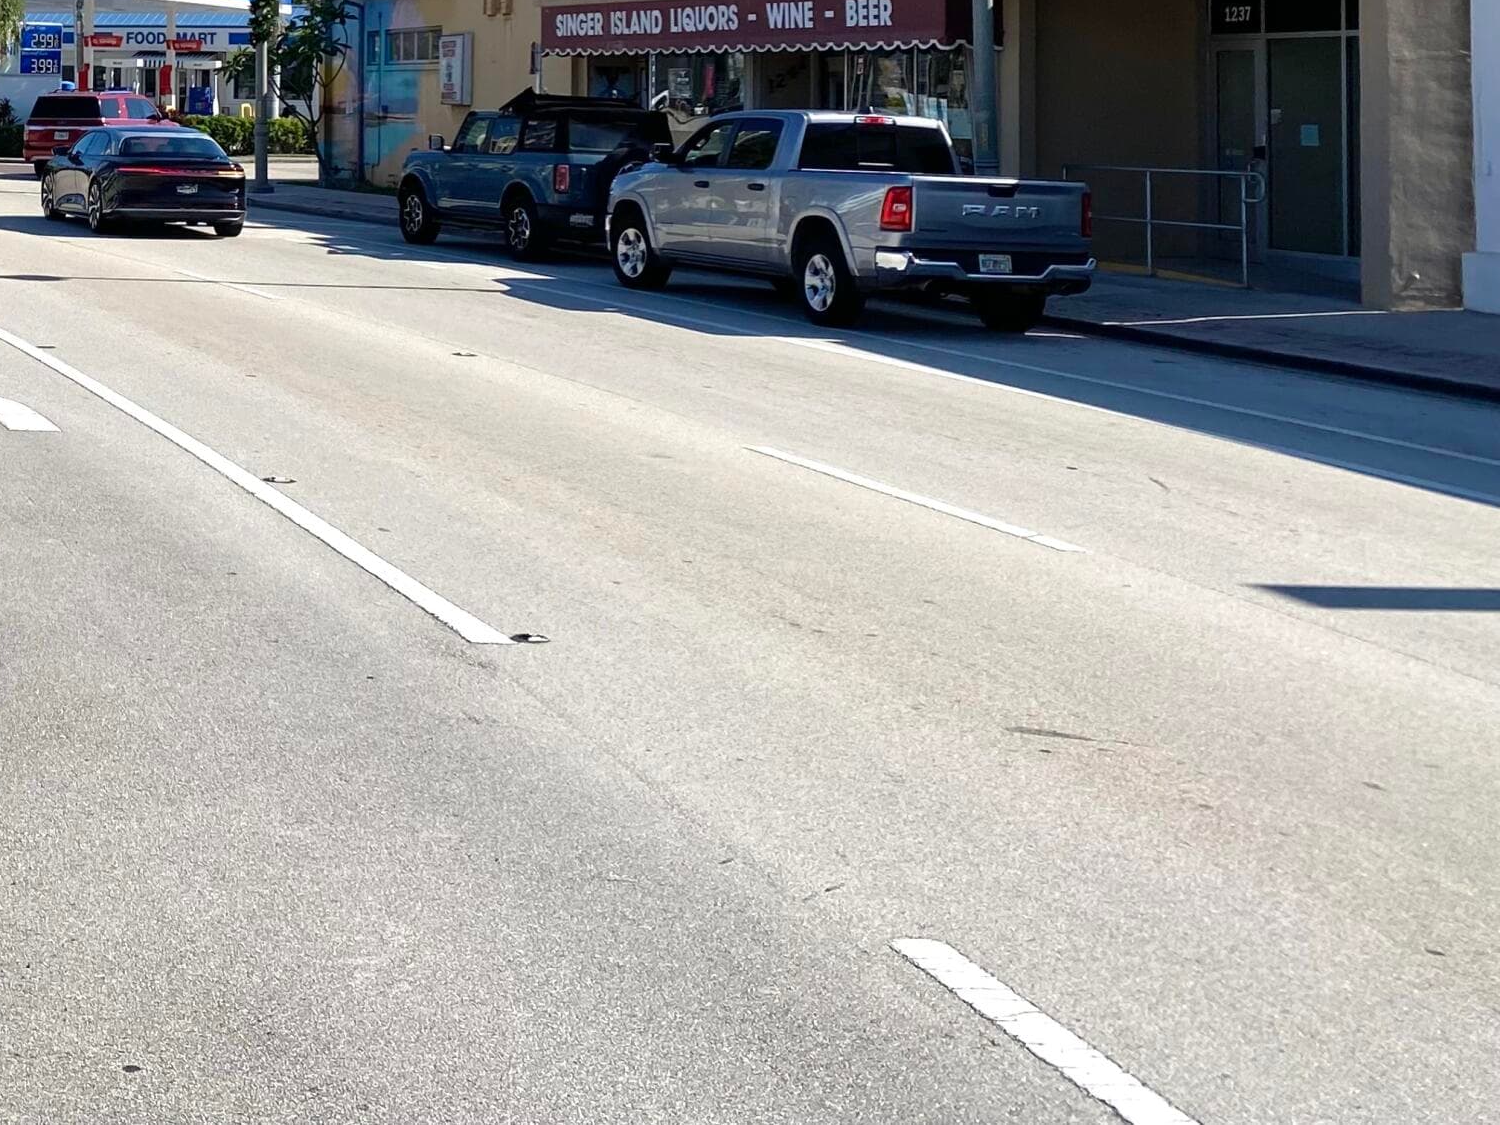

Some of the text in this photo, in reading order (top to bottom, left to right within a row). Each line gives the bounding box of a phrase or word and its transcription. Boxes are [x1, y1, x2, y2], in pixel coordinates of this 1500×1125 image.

[555, 12, 603, 37] SINGER
[610, 10, 662, 35] ISLAND
[669, 4, 739, 33] LIQUORS
[765, 1, 814, 29] WINE
[1225, 6, 1251, 22] 1237
[126, 32, 217, 45] FOOD MART
[962, 204, 1041, 218] RAM
